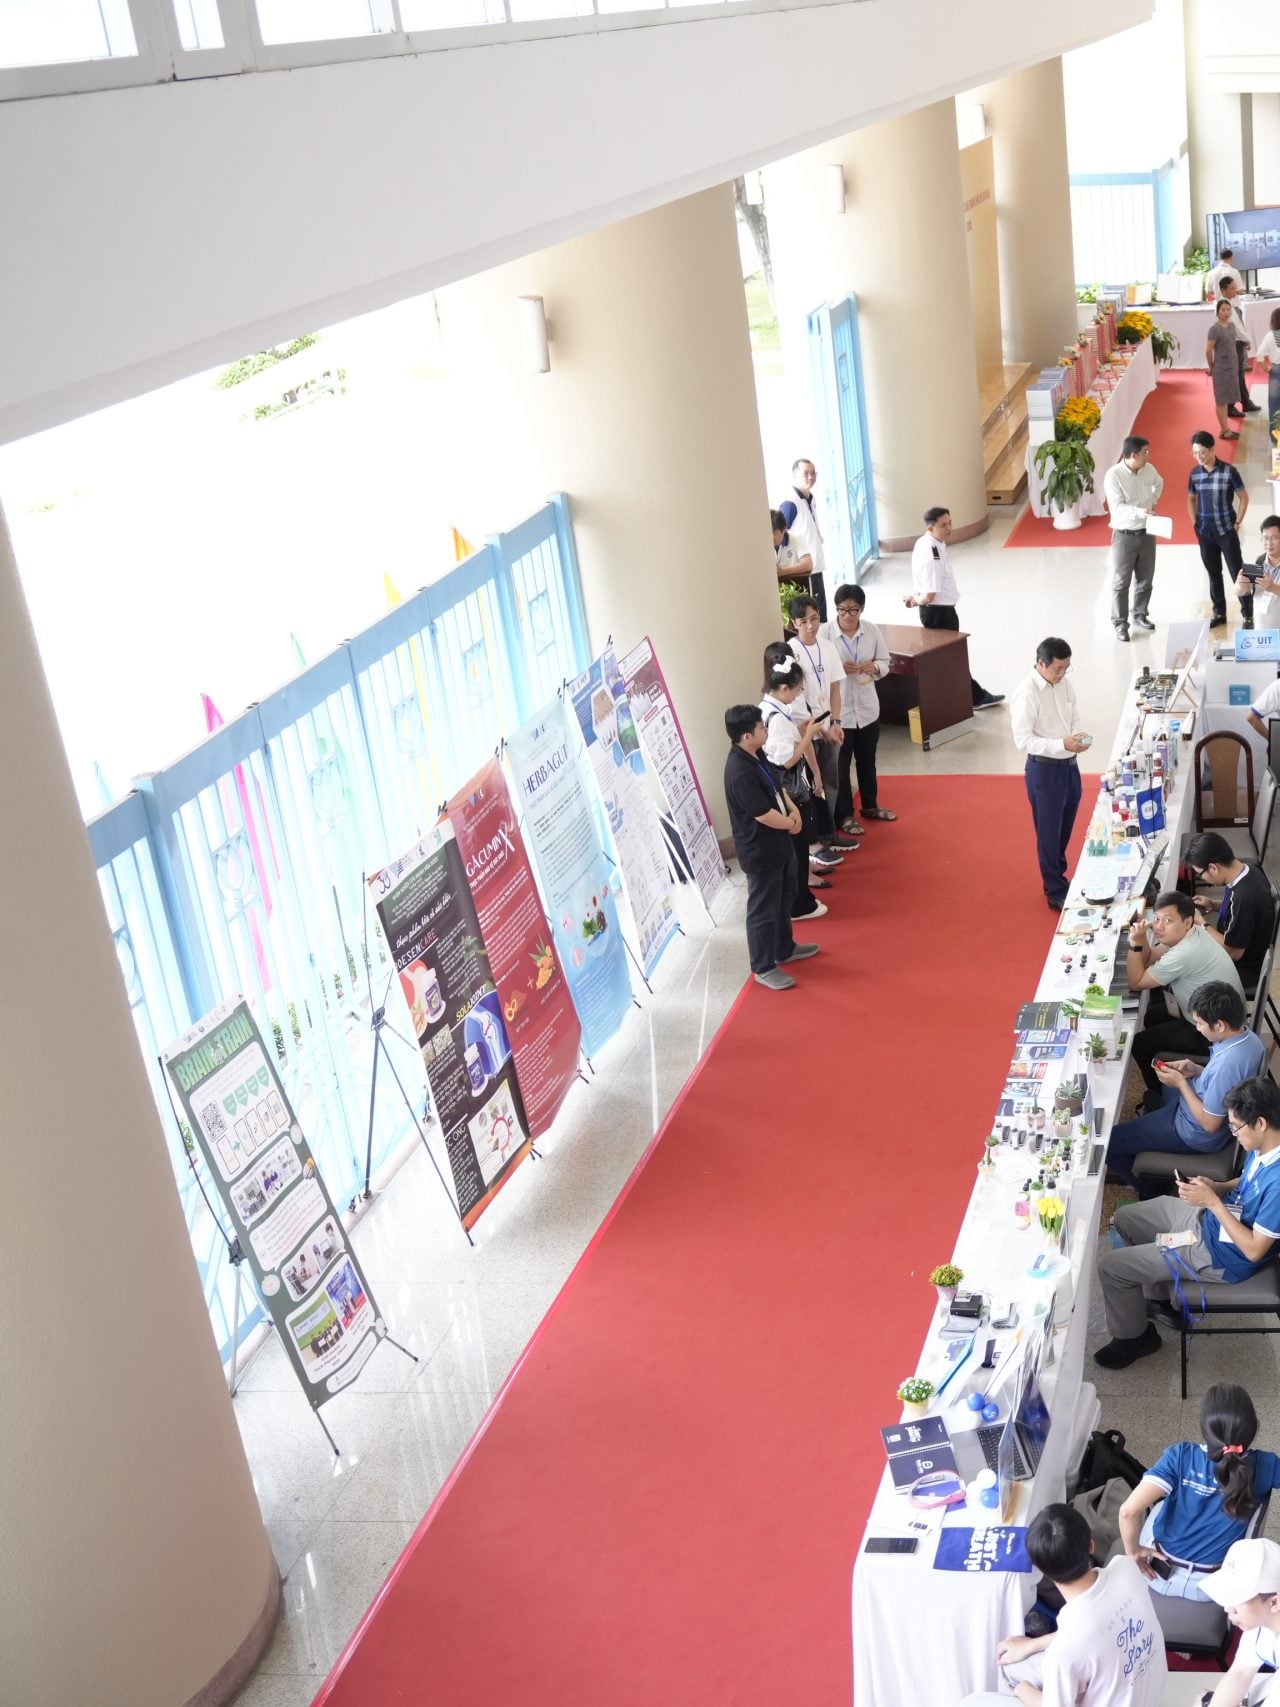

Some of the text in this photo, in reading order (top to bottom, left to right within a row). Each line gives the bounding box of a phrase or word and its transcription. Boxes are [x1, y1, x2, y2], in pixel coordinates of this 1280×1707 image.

[1257, 636, 1273, 645] UIT
[523, 742, 570, 799] HERBAGUT
[395, 927, 438, 971] OESENCARE
[175, 1013, 254, 1092] BRAIN TRAIN
[1117, 1618, 1145, 1653] The
[1123, 1632, 1155, 1679] Story
